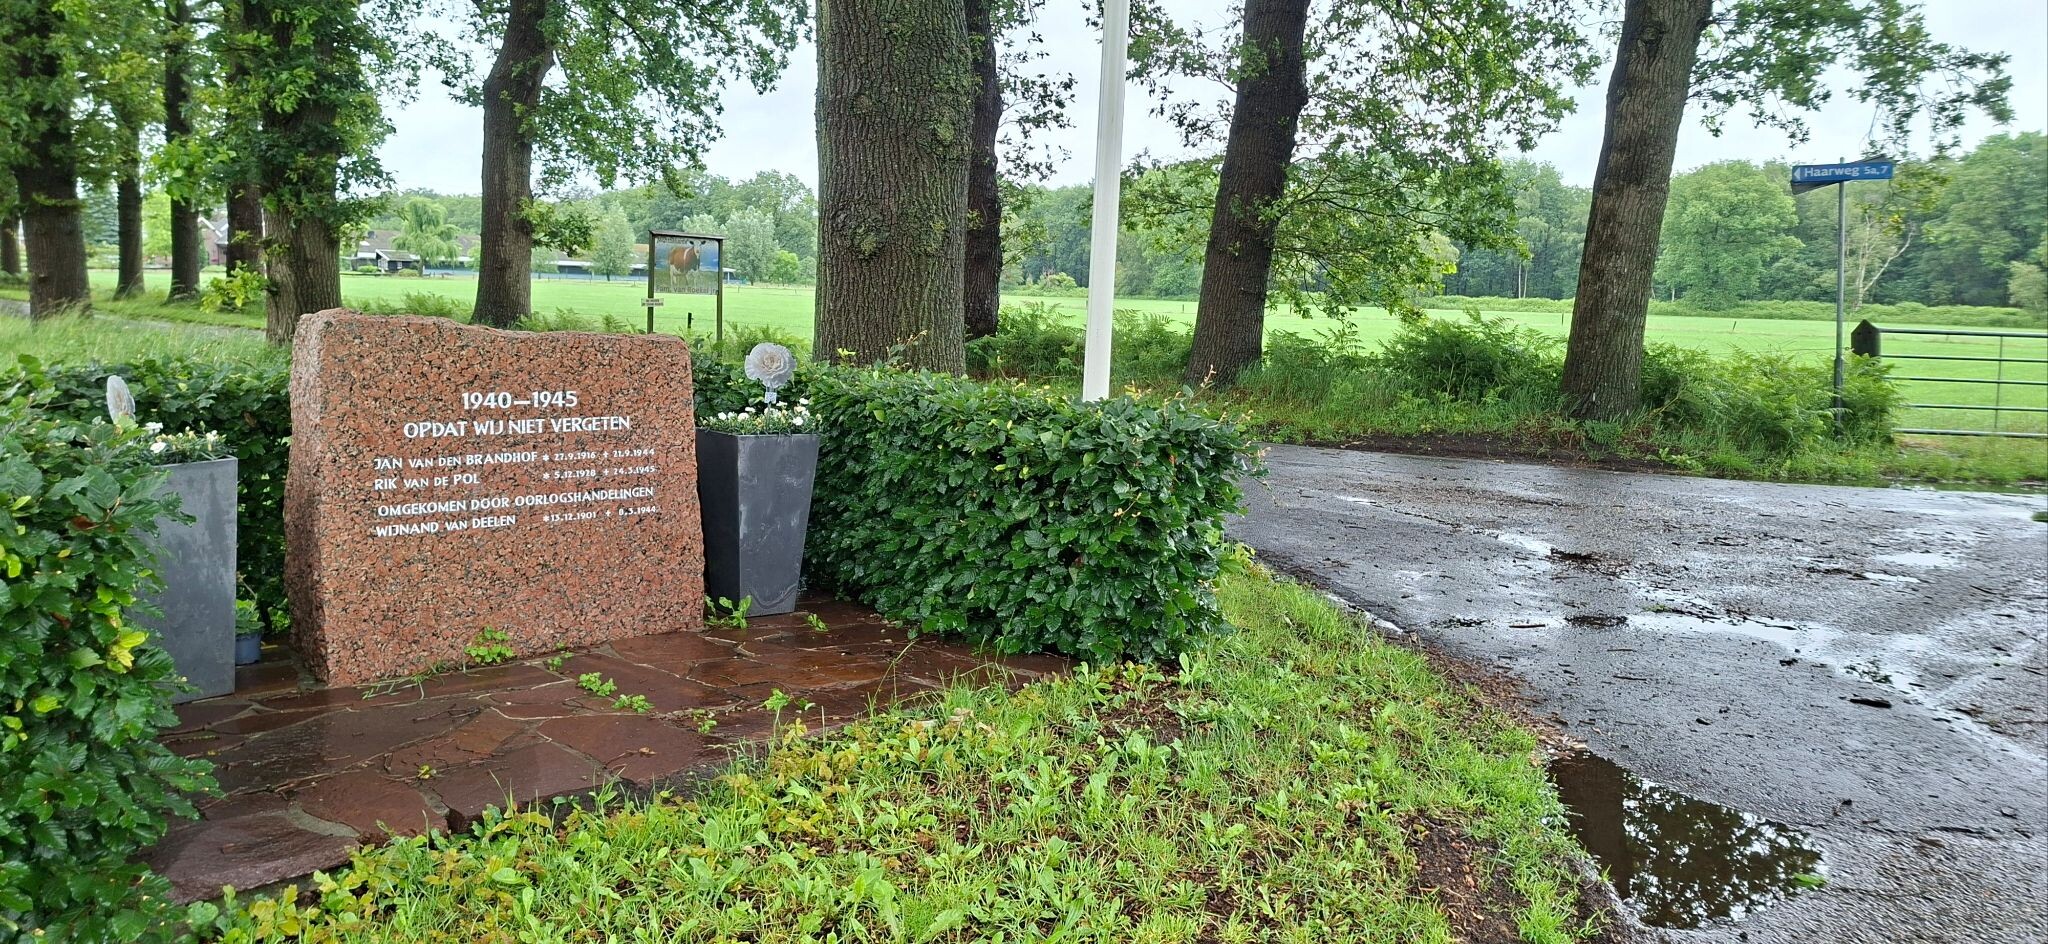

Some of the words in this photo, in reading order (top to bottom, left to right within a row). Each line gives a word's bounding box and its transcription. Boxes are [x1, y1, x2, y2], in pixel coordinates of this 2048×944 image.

[1804, 167, 1860, 177] Haarweg
[1864, 166, 1889, 174] 5a,7
[403, 421, 467, 438] OPDAT
[473, 420, 504, 436] WIJ
[508, 418, 545, 434] NIET
[551, 416, 630, 433] VERGETEN
[374, 458, 402, 470] JAN
[409, 457, 434, 468] VAN
[438, 456, 461, 467] DEN
[466, 451, 537, 465] BRANDHOF
[554, 452, 596, 461] 27.9.1916
[613, 449, 655, 458] 21.9.1944
[374, 478, 397, 490] RIK
[404, 478, 429, 488] VAN
[434, 476, 449, 487] DE
[453, 474, 480, 486] POL
[554, 470, 596, 479] 5.12.1928
[614, 466, 656, 475] 24.3.1945
[378, 500, 467, 517] OMGEKOMEN
[471, 497, 510, 509] DOOR
[514, 487, 654, 506] OORLOGSHANDELINGEN
[376, 522, 439, 537] WIJNAND
[445, 520, 468, 531] VAN
[472, 515, 516, 529] DEELEN
